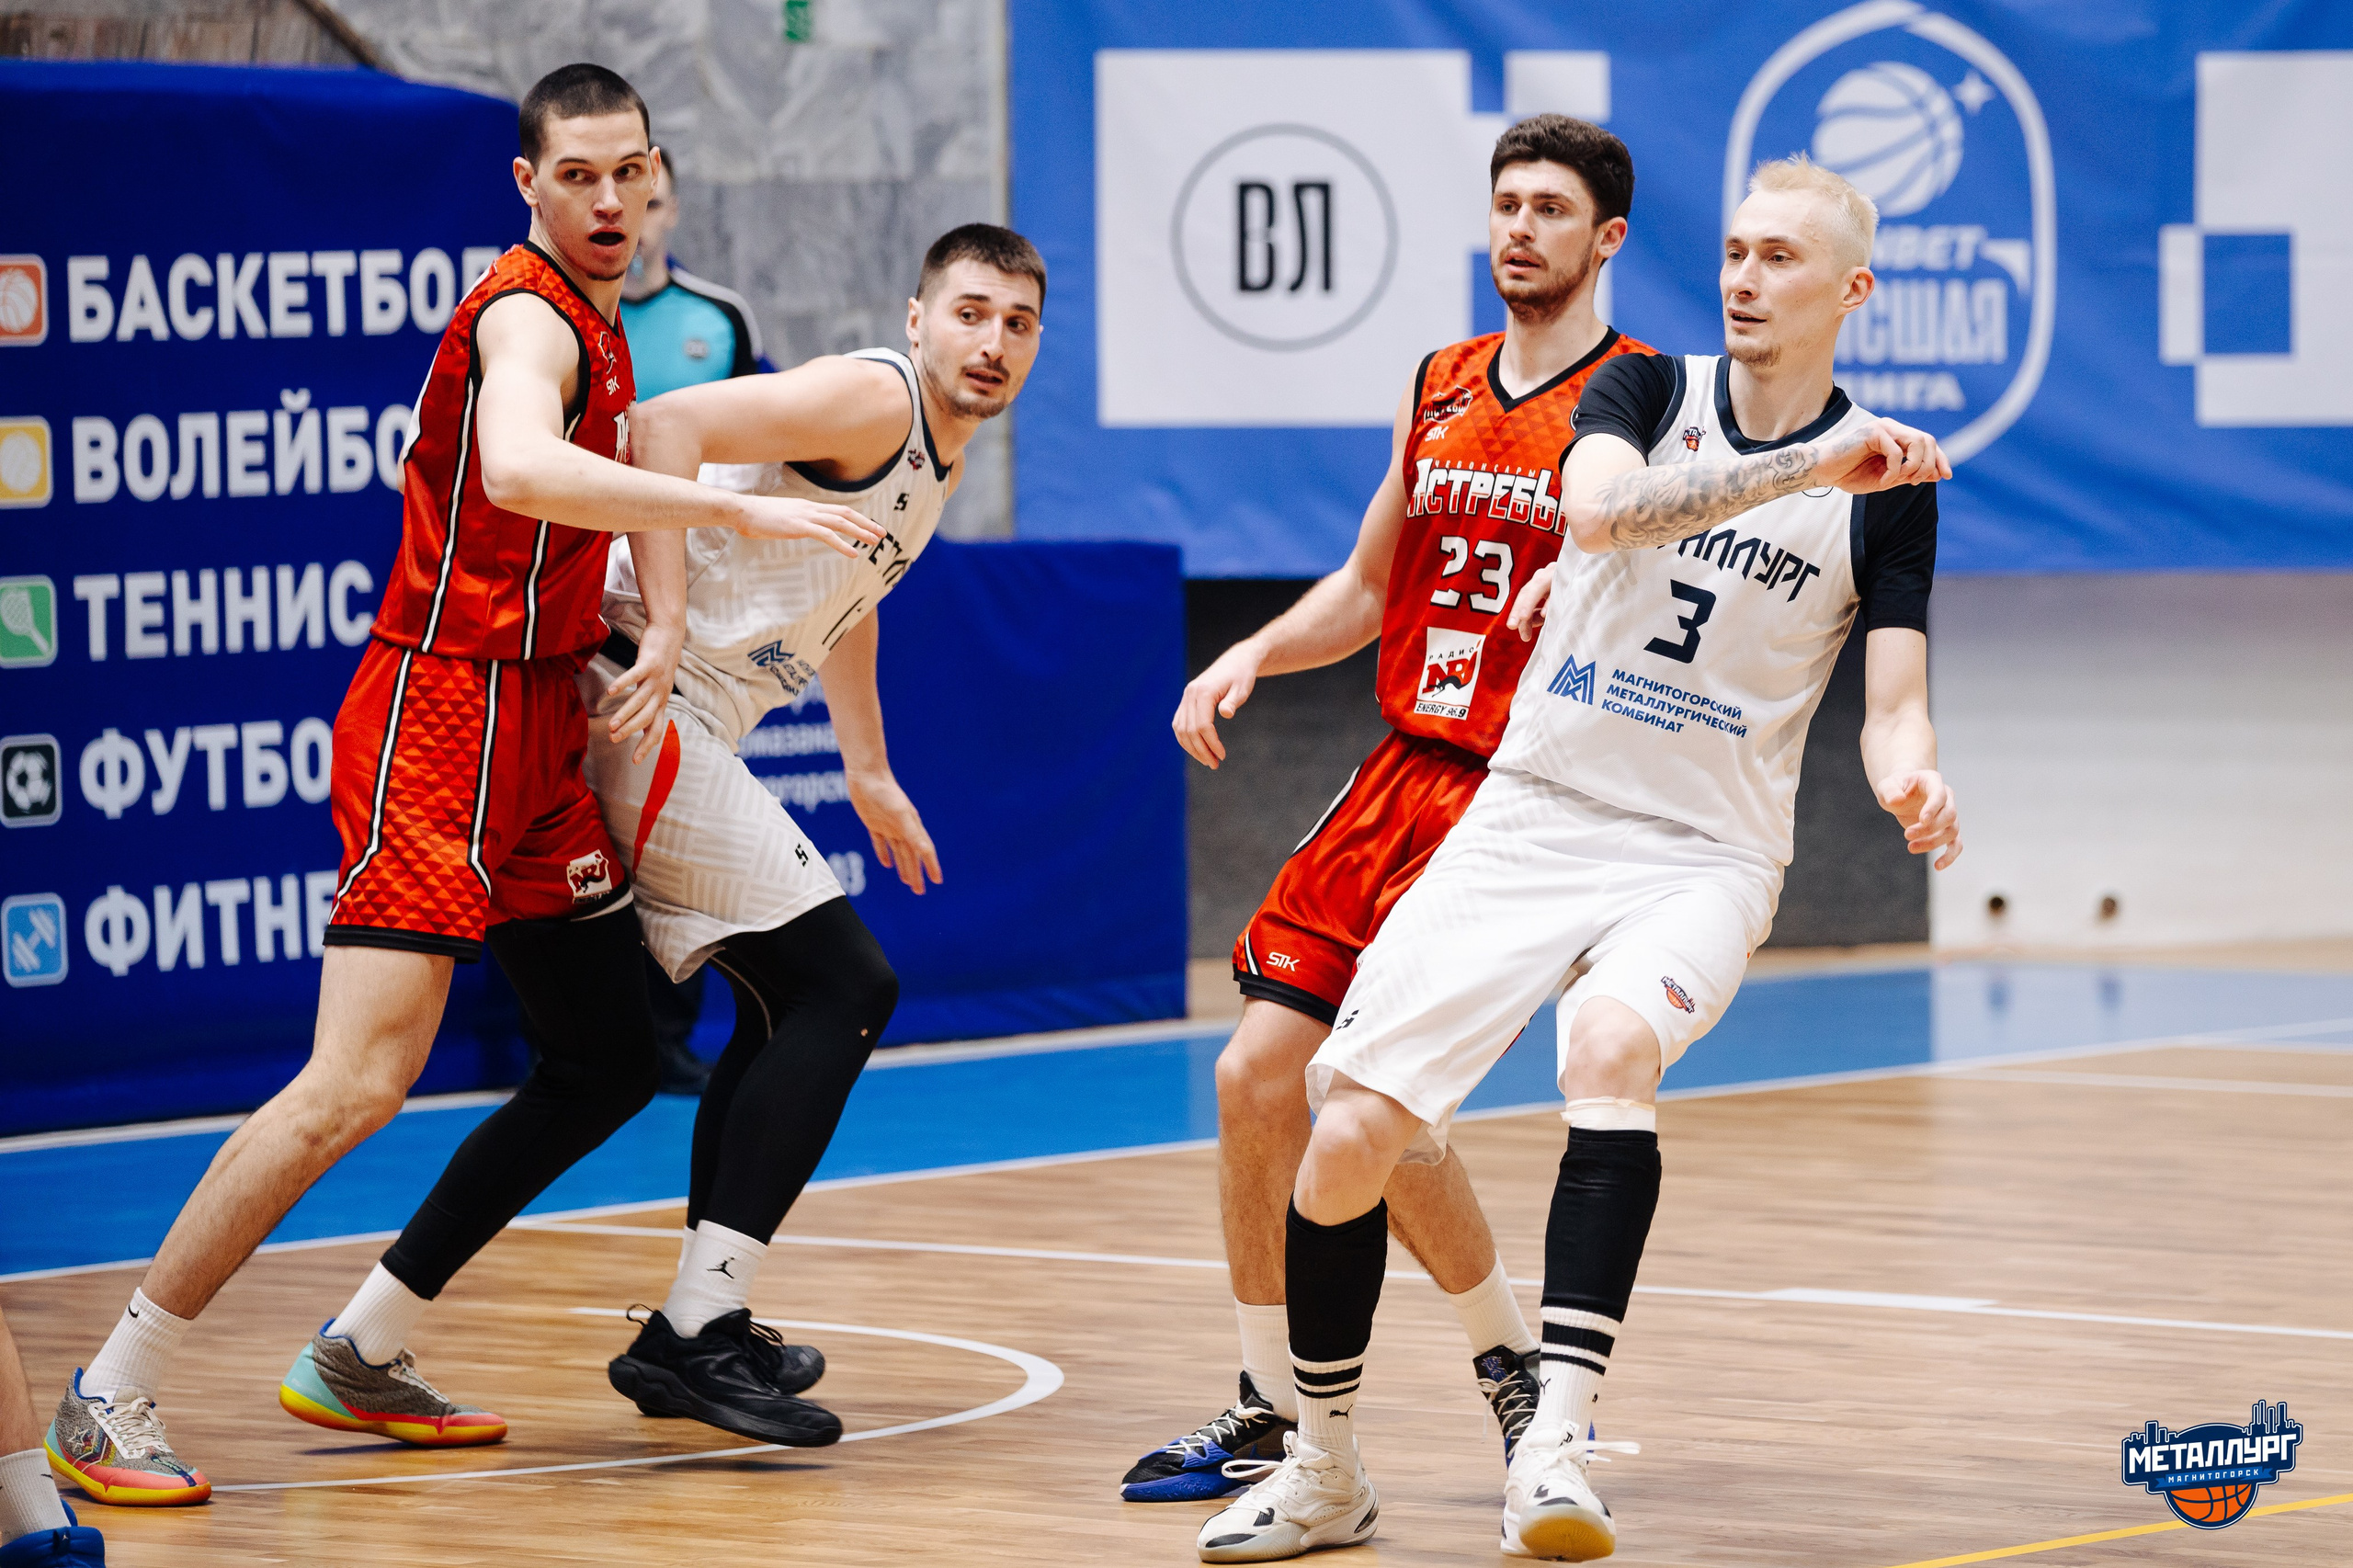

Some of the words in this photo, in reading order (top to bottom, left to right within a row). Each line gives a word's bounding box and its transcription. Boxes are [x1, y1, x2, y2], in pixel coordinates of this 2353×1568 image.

[1832, 278, 2008, 364] СШАЯ
[73, 388, 414, 504] ВОЛЕЙБО
[1425, 426, 1449, 442] STK
[1434, 460, 1536, 477] ЧЕБОКСАРЫ
[1430, 536, 1515, 615] 23
[1657, 528, 1821, 603] АЛЛУРГ
[74, 560, 374, 662] ТЕННИС
[1643, 579, 1716, 664] 3
[1428, 646, 1474, 662] РАДИО
[1416, 702, 1446, 715] ENERGY
[1601, 699, 1685, 733] КОМБИНАТ
[1606, 684, 1747, 738] МЕТАЛЛУРГИЧЕСКИЙ
[1611, 668, 1743, 721] МАГНИТОГОРСКИЙ
[79, 717, 332, 820] ФУТБО
[84, 869, 339, 977] ФИТНЕ
[1266, 951, 1301, 972] STK
